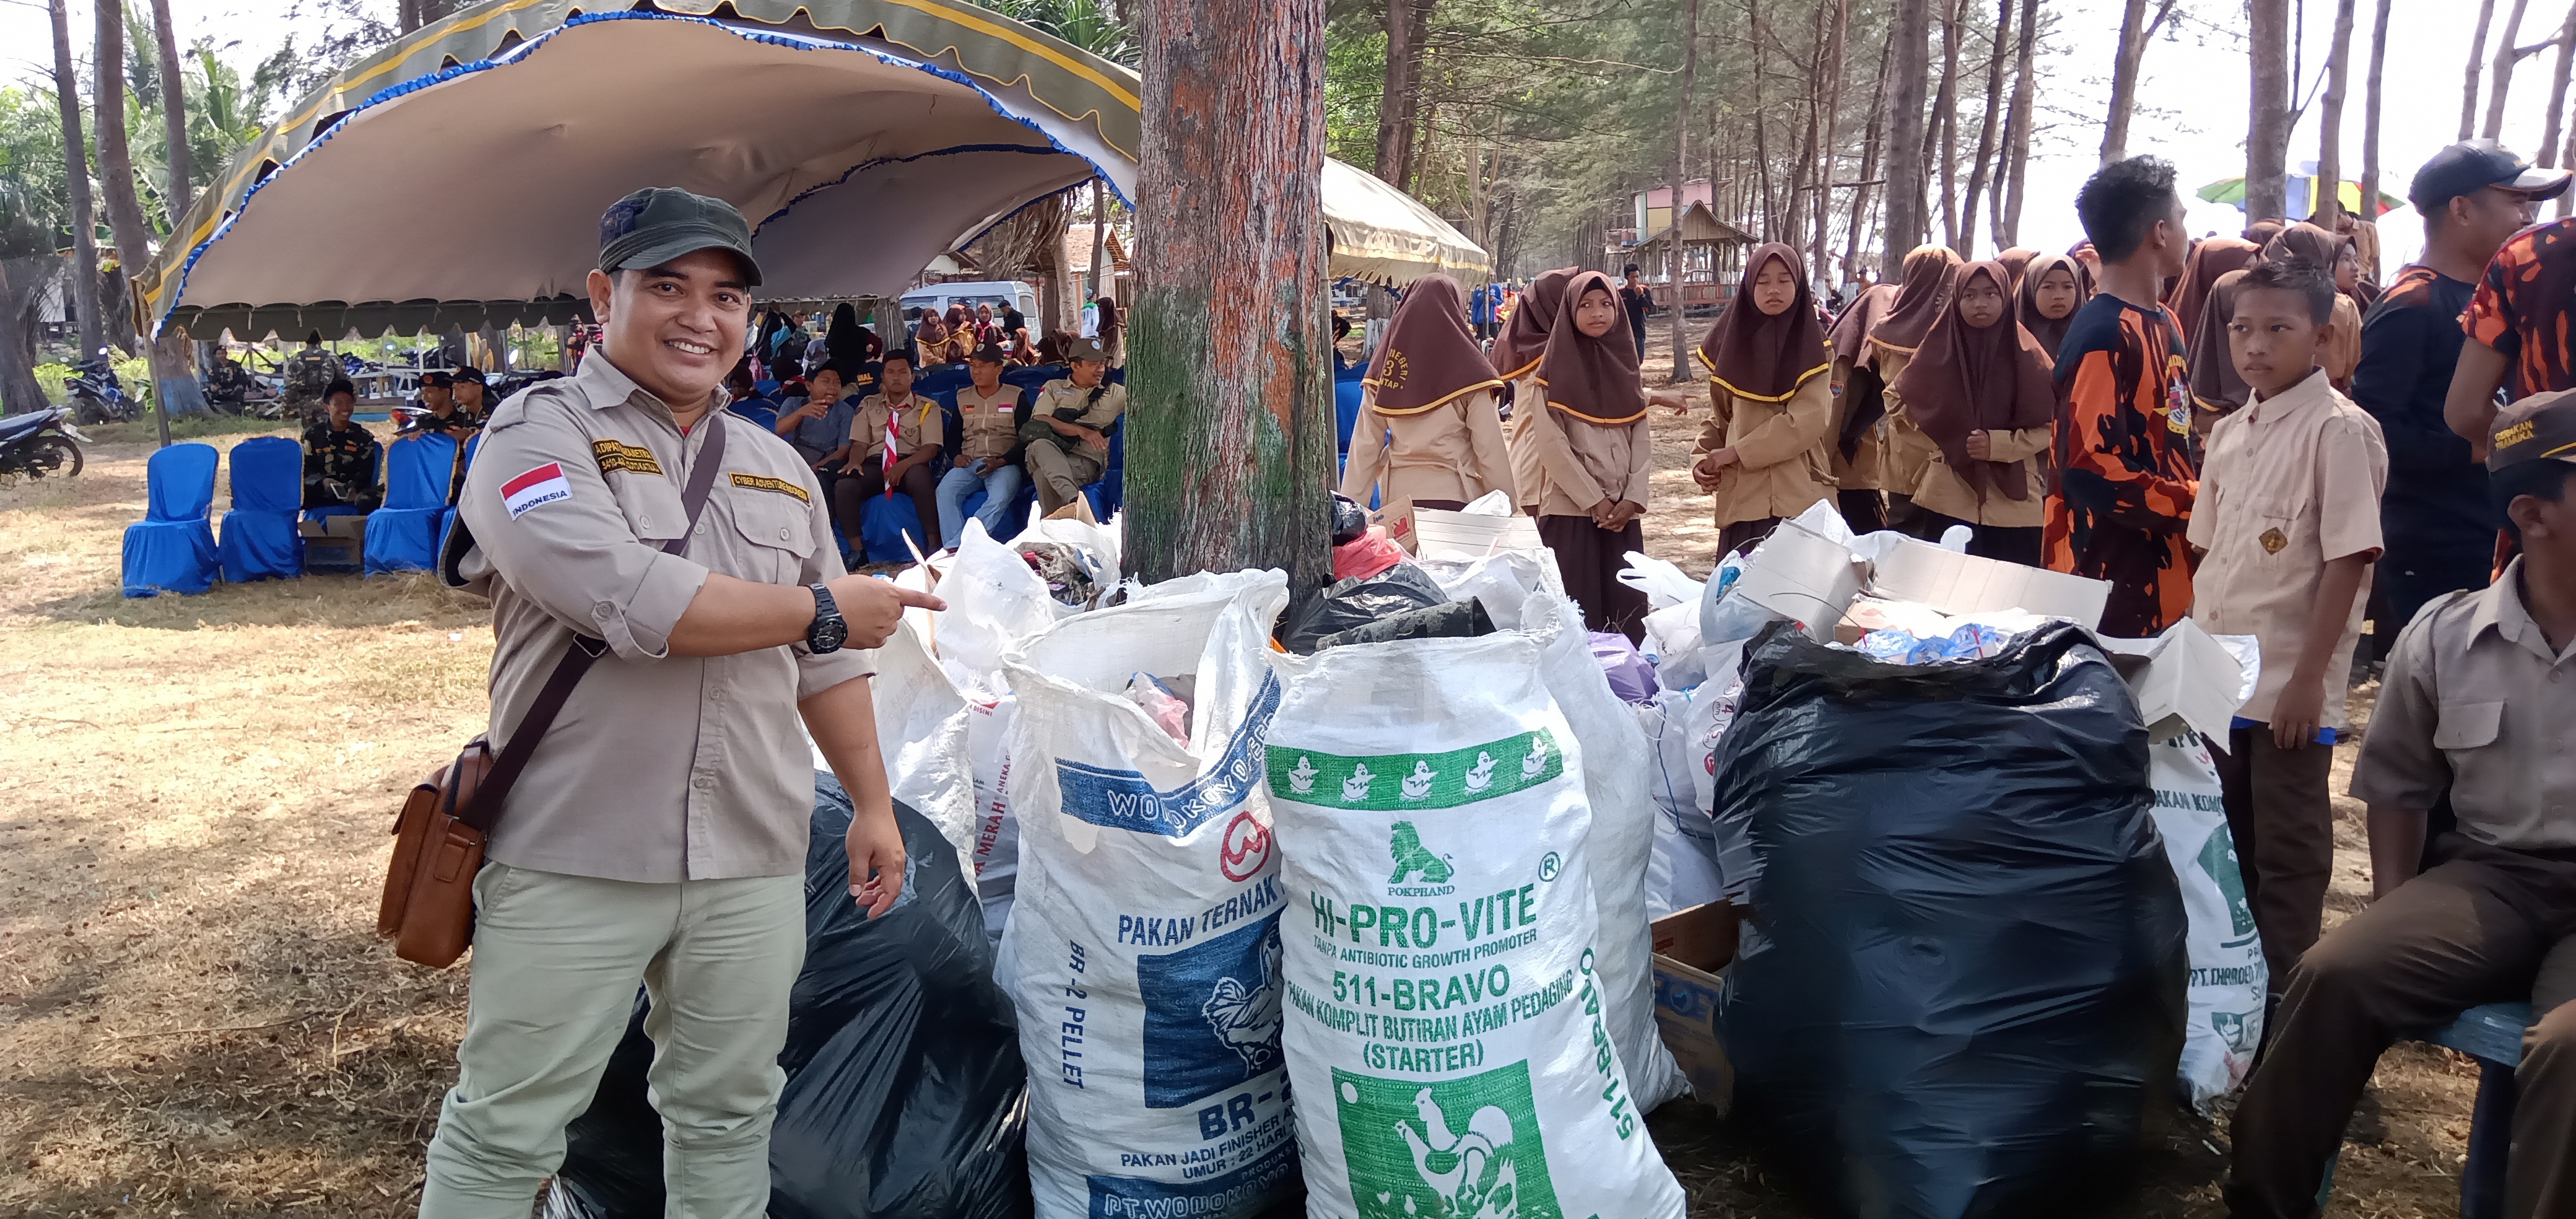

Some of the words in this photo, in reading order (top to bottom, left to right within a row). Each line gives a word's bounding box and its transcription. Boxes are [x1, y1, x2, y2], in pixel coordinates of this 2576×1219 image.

[1379, 377, 1399, 389] NTAP
[1383, 360, 1395, 376] 3
[1389, 349, 1408, 381] NEGERI
[735, 476, 755, 486] CYBER
[512, 490, 568, 517] INDONESIA
[976, 801, 1006, 857] MERAH
[1118, 914, 1195, 946] PAKAN
[1201, 873, 1278, 933] TERNAK
[1388, 885, 1455, 897] POKPHAND
[1310, 883, 1537, 949] HI-PRO-VITE
[1313, 934, 1337, 959] TANPA
[1340, 948, 1408, 968] ANTIBIOTIC
[1412, 948, 1471, 969] GROWTH
[1474, 928, 1537, 959] PROMOTER
[1287, 979, 1314, 1018] PAKAN
[1316, 1001, 1378, 1038] KOMPLIT
[1383, 1015, 1457, 1042] BUTIRAN
[1462, 1002, 1509, 1038] AYAM
[1512, 969, 1573, 1023] PEDAGING
[1333, 964, 1510, 1011] 511-BRAVO
[1062, 1007, 1086, 1089] PELLET
[1363, 1039, 1484, 1073] (STARTER)
[1121, 1153, 1177, 1167] PAKAN
[1180, 1147, 1216, 1165] JADI
[1219, 1115, 1280, 1157] FINISHER
[1182, 1158, 1227, 1179] UMUR
[1238, 1147, 1254, 1163] 22
[1257, 1125, 1287, 1153] HARI
